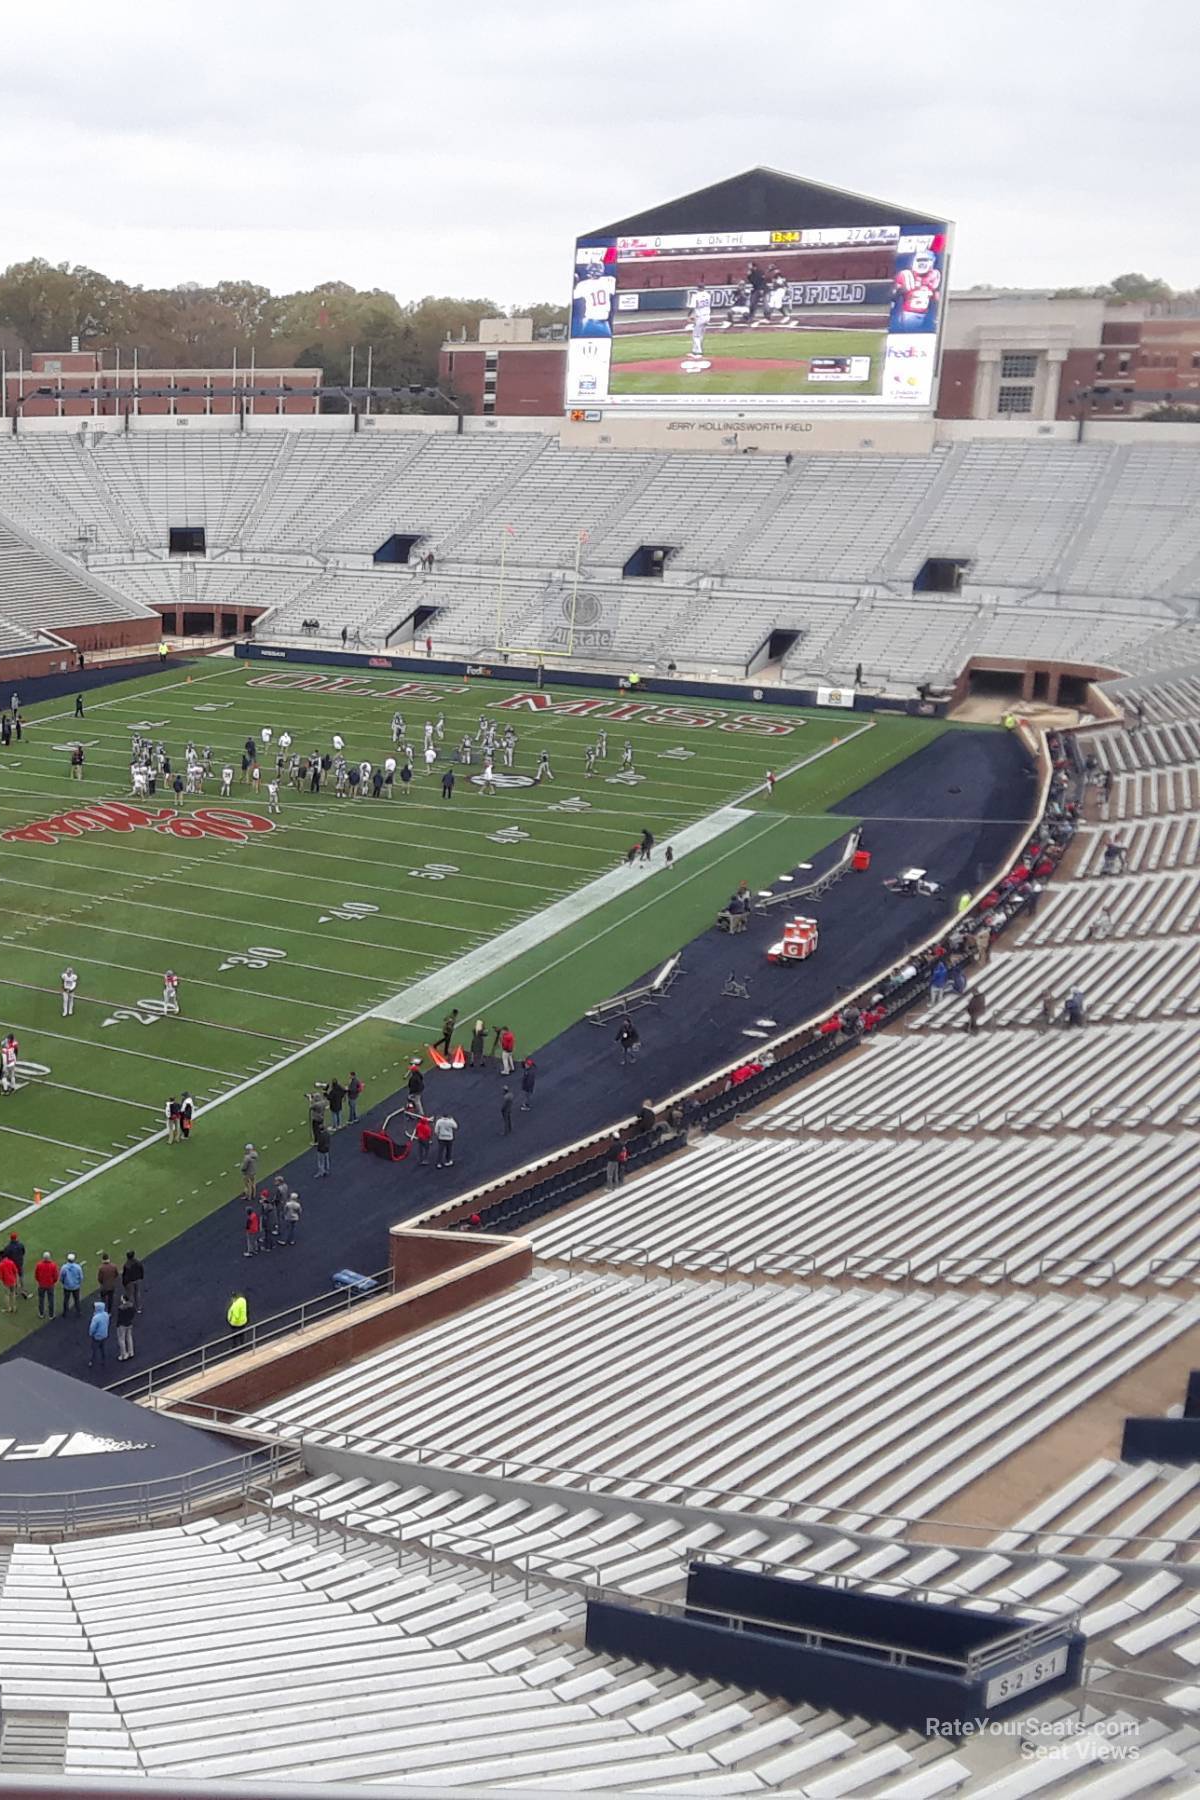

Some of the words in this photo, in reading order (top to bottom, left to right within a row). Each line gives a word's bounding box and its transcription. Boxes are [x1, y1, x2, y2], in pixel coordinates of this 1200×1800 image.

[805, 284, 866, 304] FIELD
[666, 422, 696, 431] JERRY
[699, 422, 783, 432] HOLLINGSWORTH
[785, 422, 813, 432] FIELD
[245, 672, 470, 703] OLE
[486, 691, 807, 735] MISS
[154, 807, 275, 843] Ole
[408, 863, 461, 881] 50
[329, 902, 380, 921] 40
[227, 946, 287, 970] 30
[113, 999, 180, 1025] 20
[1000, 1673, 1023, 1696] S-2
[1034, 1657, 1056, 1680] S-1
